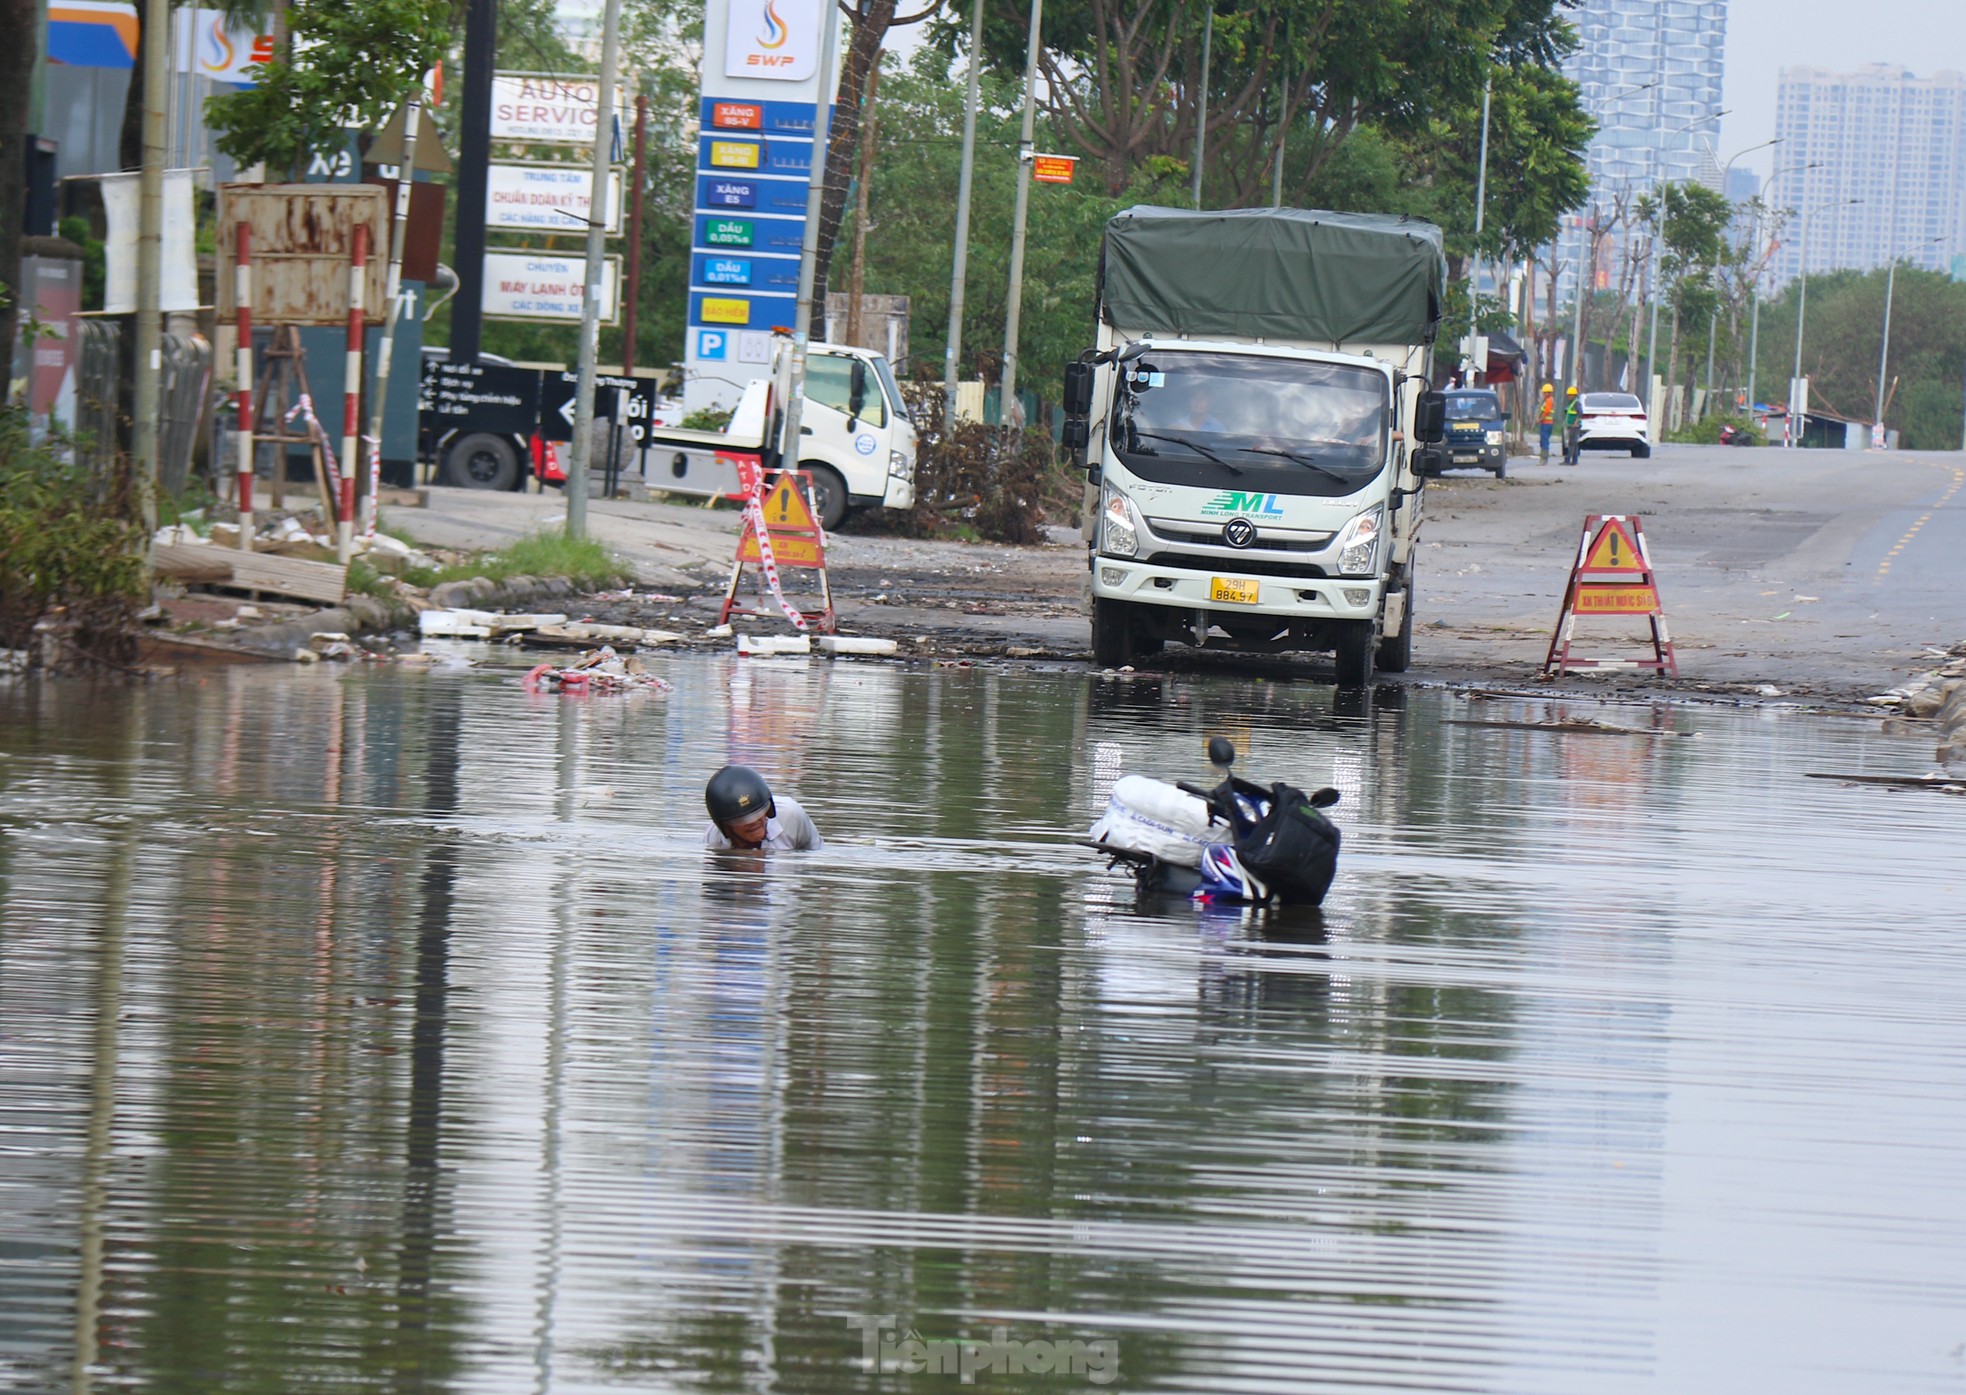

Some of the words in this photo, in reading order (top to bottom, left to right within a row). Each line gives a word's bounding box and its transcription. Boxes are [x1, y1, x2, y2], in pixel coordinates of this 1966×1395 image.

[746, 54, 794, 66] SWP
[520, 81, 593, 101] AUTO
[497, 104, 598, 125] SERVIC
[721, 105, 754, 117] XĂNG
[719, 145, 752, 156] XĂNG
[524, 171, 557, 182] TRUNG
[716, 183, 750, 195] XĂNG
[724, 195, 740, 204] E5
[527, 262, 568, 273] CHUYÊN
[568, 303, 580, 313] XE
[701, 333, 722, 356] P
[1215, 491, 1284, 514] ML
[1242, 512, 1282, 520] TRANSPORT
[1225, 580, 1246, 590] 29H
[1216, 590, 1253, 602] 884.97
